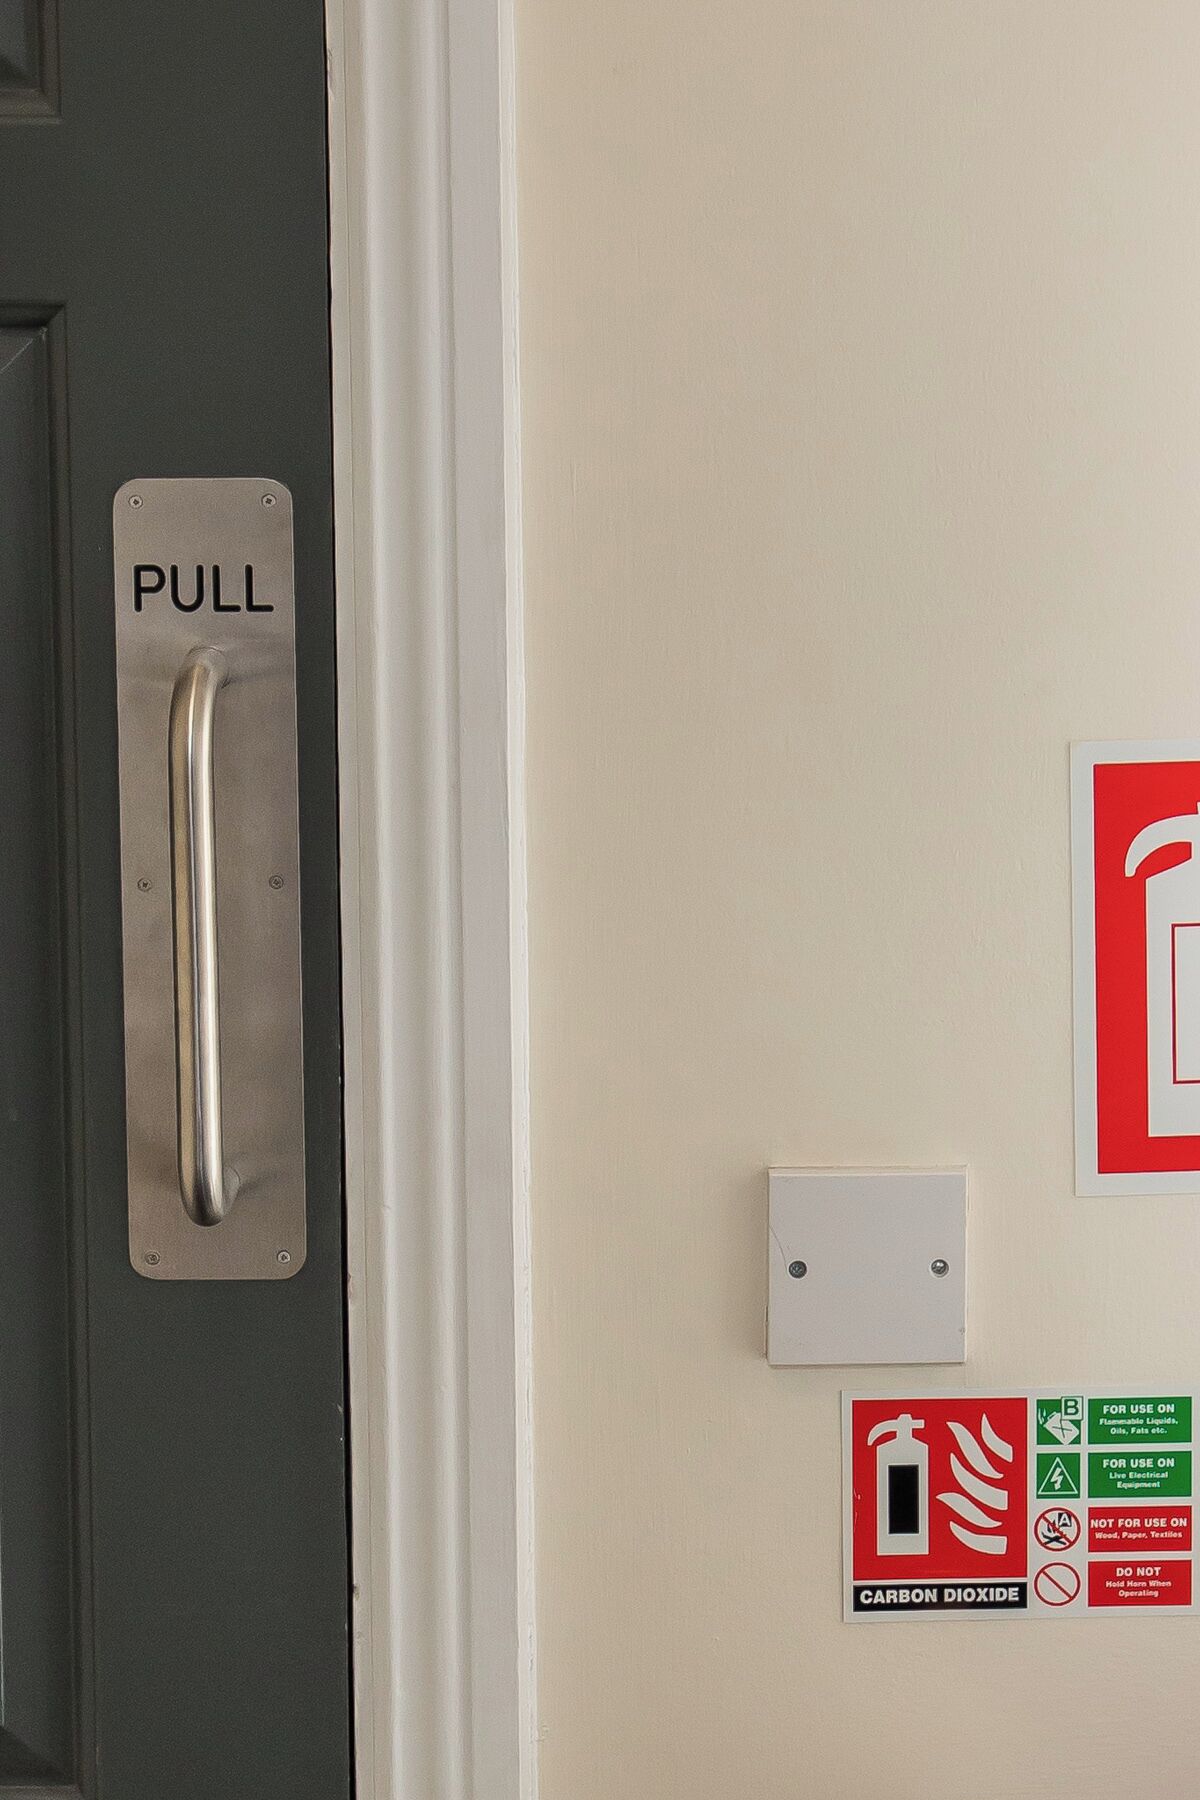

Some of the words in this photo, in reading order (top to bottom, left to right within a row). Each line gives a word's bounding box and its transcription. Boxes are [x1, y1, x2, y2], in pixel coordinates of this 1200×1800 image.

[133, 564, 274, 613] PULL
[1064, 1399, 1079, 1416] B
[1103, 1405, 1126, 1414] FOR
[1130, 1404, 1153, 1413] USE
[1157, 1403, 1175, 1413] ON
[1146, 1417, 1178, 1425] Liquids,
[1110, 1427, 1128, 1436] Oils,
[1103, 1459, 1126, 1468] FOR
[1130, 1459, 1153, 1468] USE
[1157, 1458, 1175, 1467] ON
[1129, 1471, 1168, 1479] Electrical
[1117, 1481, 1160, 1489] Equipment
[1090, 1519, 1114, 1528] NOT
[1118, 1518, 1140, 1528] FOR
[1144, 1518, 1167, 1527] USE
[1170, 1517, 1187, 1527] ON
[1122, 1531, 1147, 1539] Paper,
[1150, 1530, 1182, 1538] Textiles
[1116, 1567, 1132, 1577] DO
[1136, 1567, 1161, 1576] NOT
[859, 1588, 938, 1605] CARBON
[944, 1586, 1020, 1603] DIOXIDE
